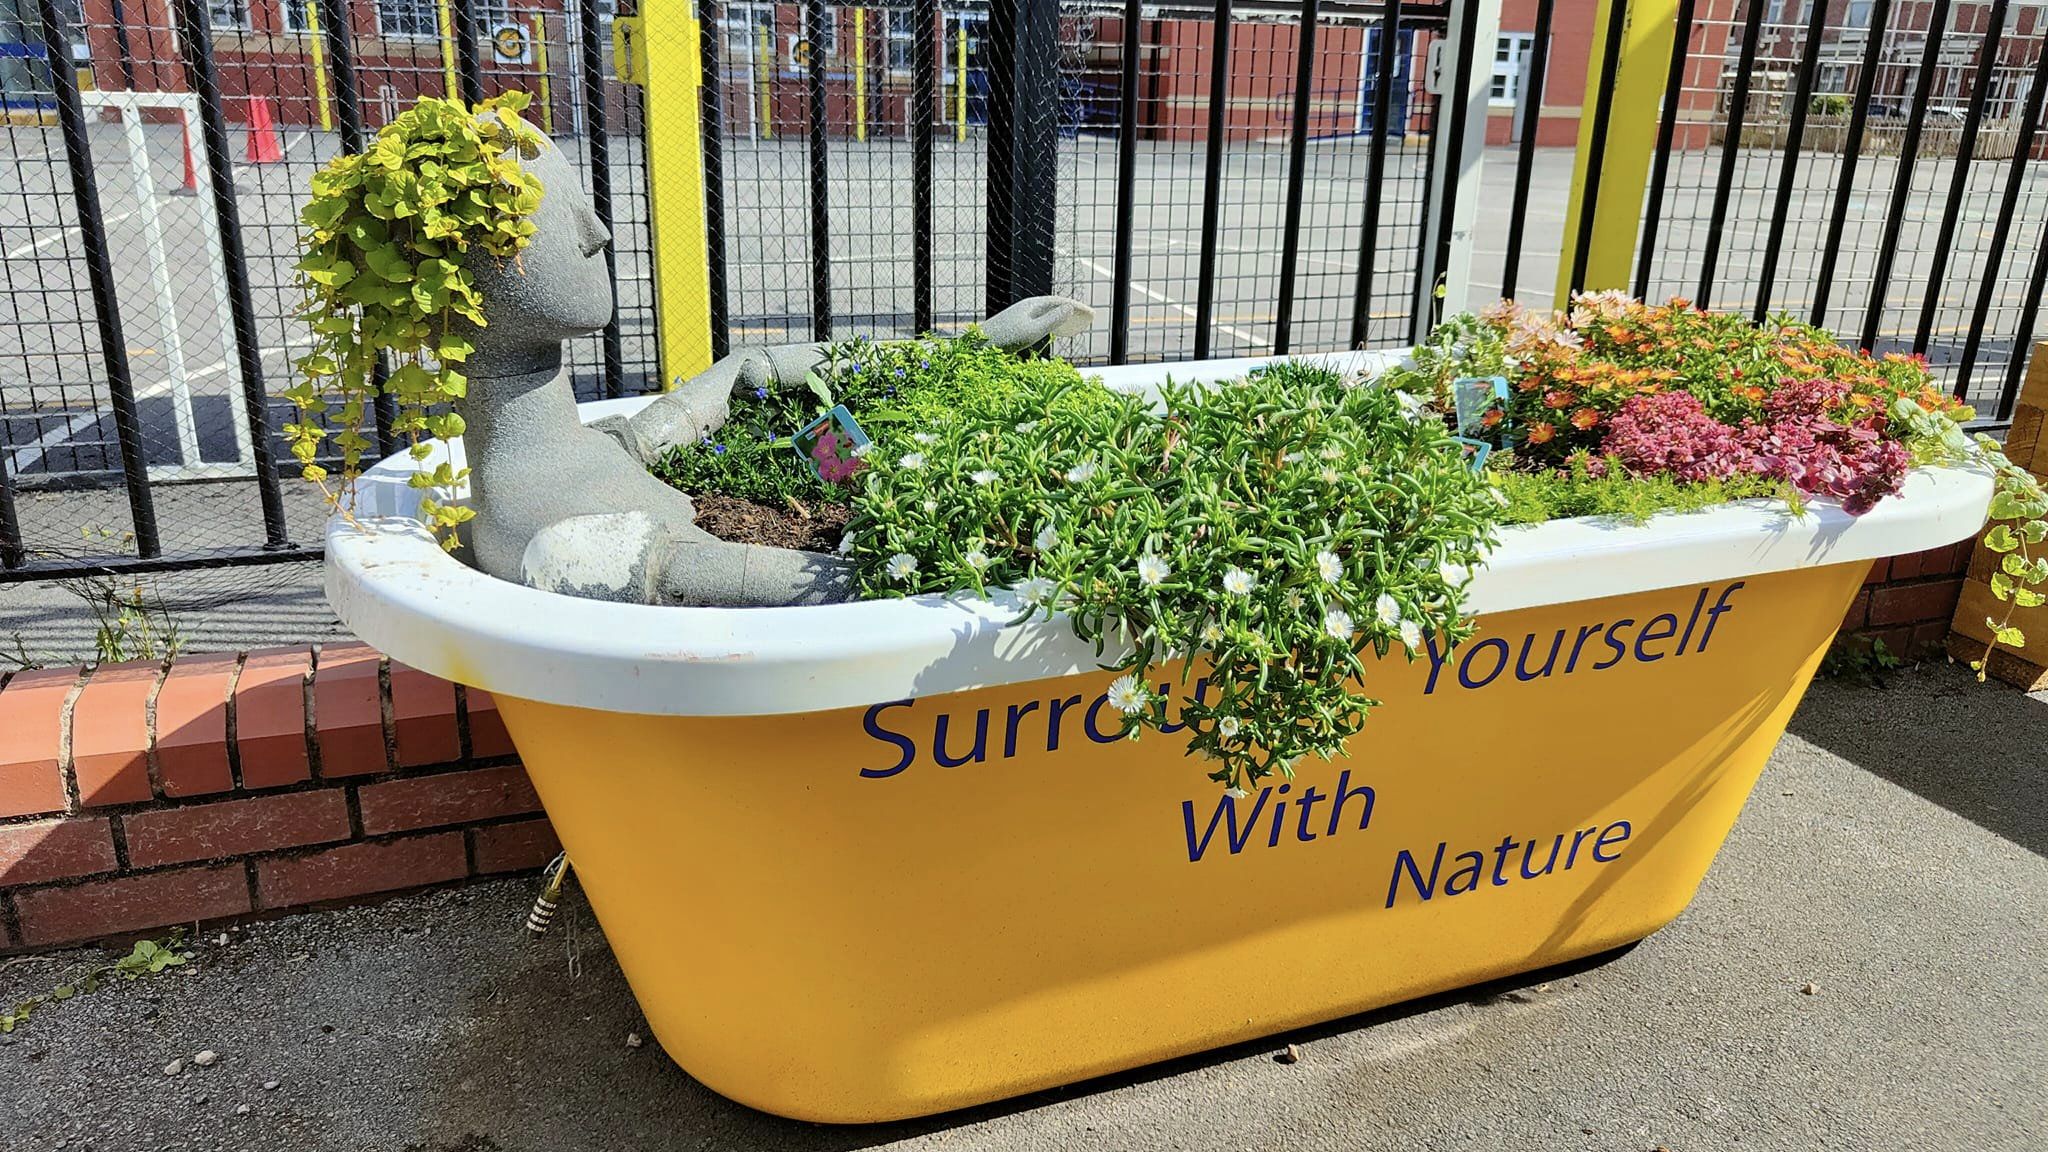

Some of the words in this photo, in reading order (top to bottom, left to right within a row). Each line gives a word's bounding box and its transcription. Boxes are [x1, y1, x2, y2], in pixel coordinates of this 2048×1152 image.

[860, 677, 1209, 778] Surrou
[1422, 581, 1745, 695] Yourself
[1181, 769, 1376, 863] With
[1385, 819, 1632, 909] Nature
